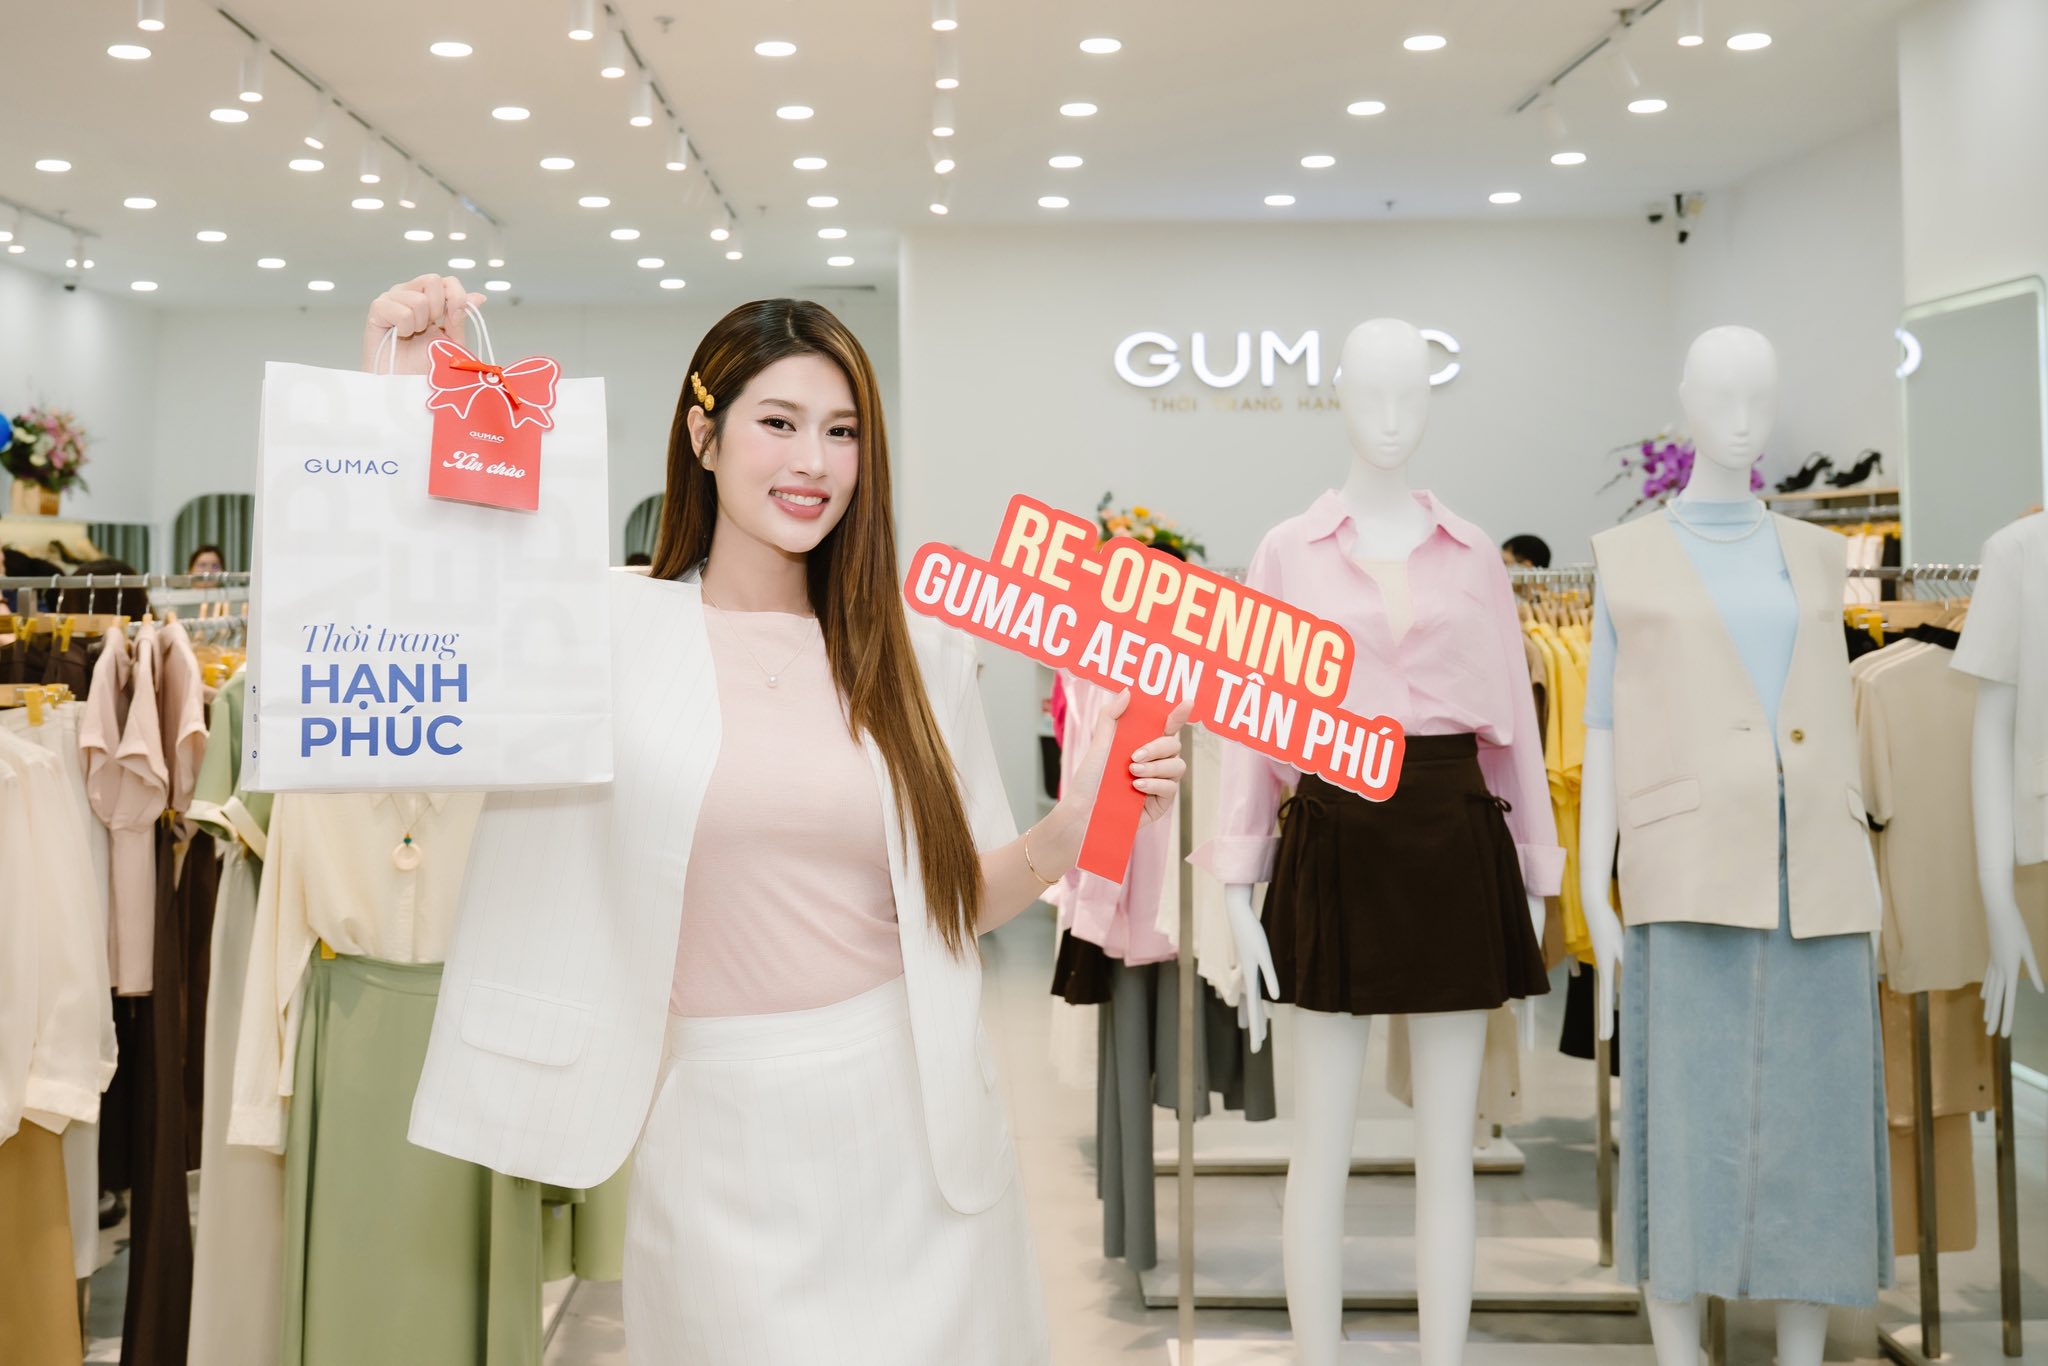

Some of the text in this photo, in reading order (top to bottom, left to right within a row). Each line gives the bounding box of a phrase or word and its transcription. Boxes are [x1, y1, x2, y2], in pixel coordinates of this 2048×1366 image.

[469, 431, 504, 442] GUMAC
[304, 458, 399, 475] GUMAC
[442, 450, 526, 478] Xin chào
[1001, 504, 1345, 698] RE-OPENING
[302, 623, 460, 661] Thời trang
[301, 663, 468, 710] HẠNH
[914, 552, 1395, 789] GUMAC AEON TÂN PHÚ
[301, 705, 464, 758] PHÚC
